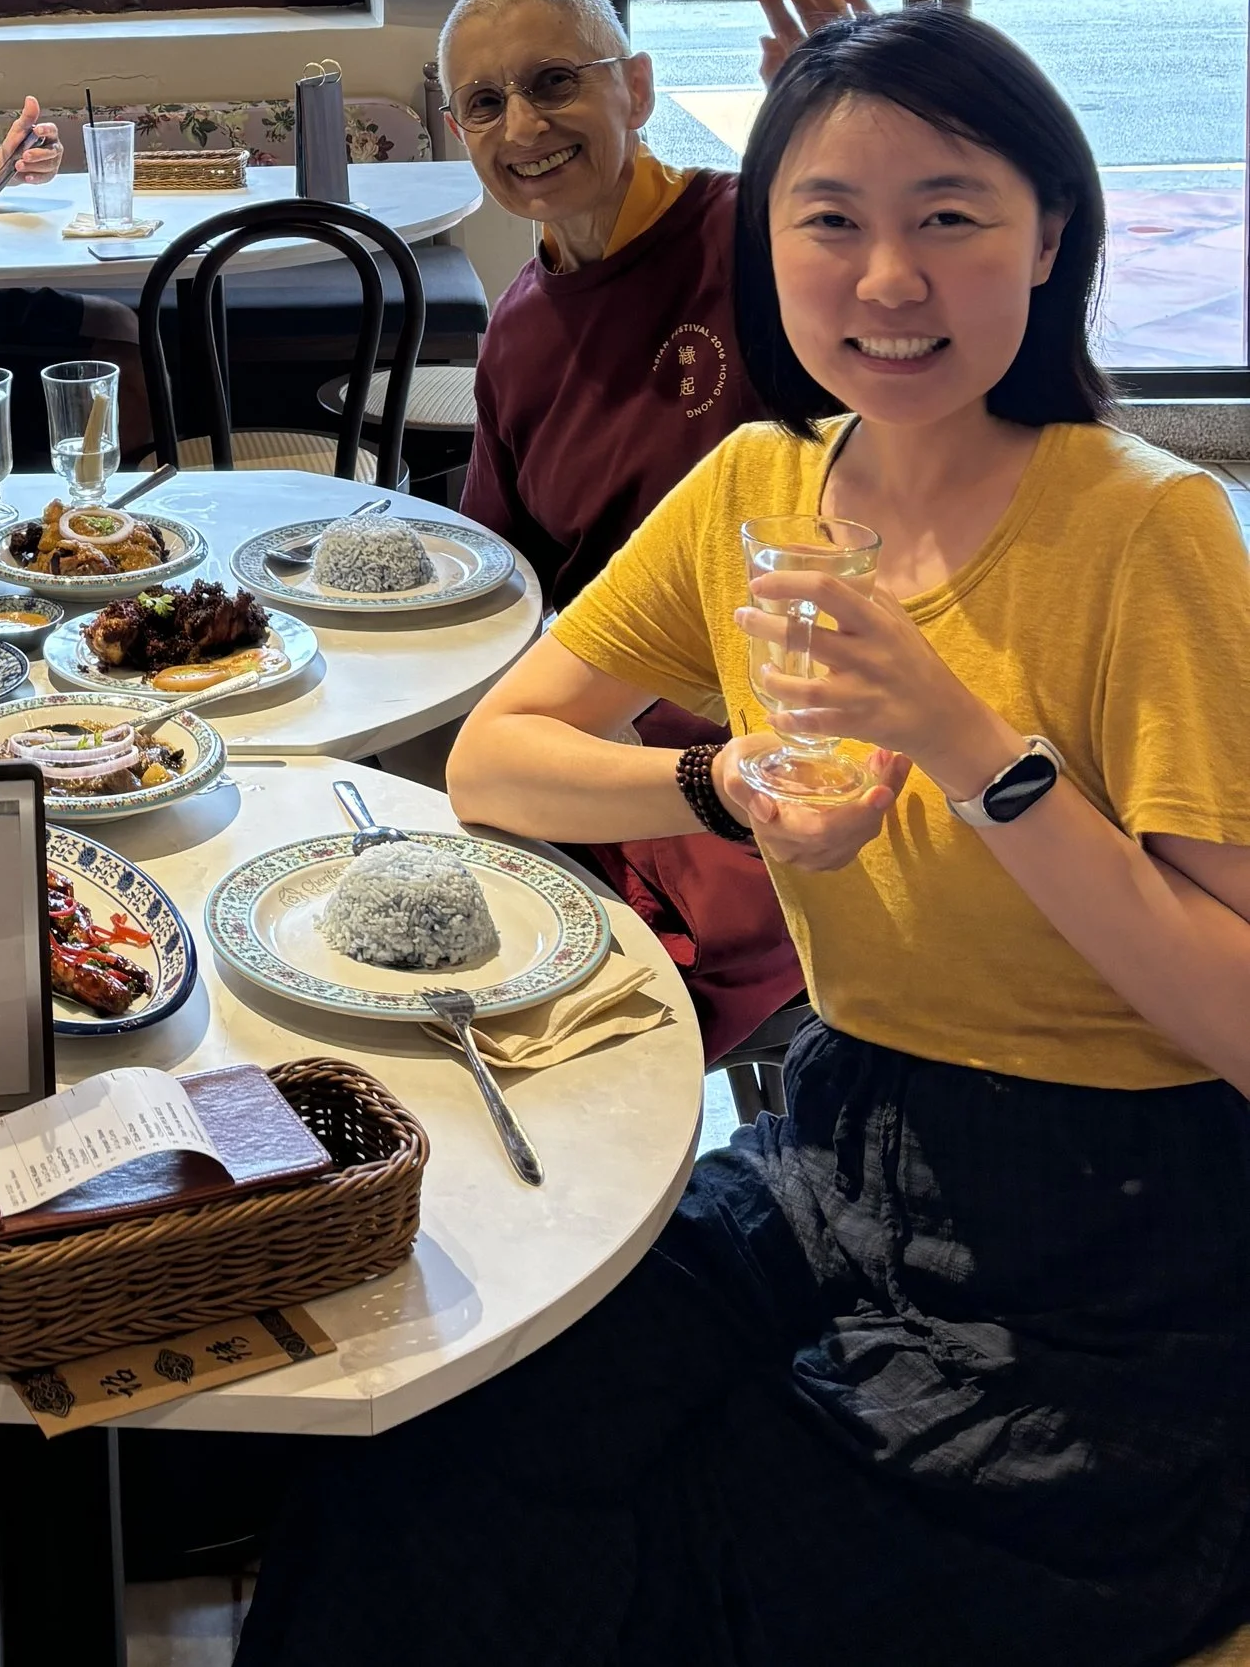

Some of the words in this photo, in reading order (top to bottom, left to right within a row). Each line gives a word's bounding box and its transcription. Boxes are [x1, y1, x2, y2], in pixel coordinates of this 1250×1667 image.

[710, 335, 727, 360] 2016
[713, 363, 727, 397] HONG
[685, 398, 714, 419] KONG
